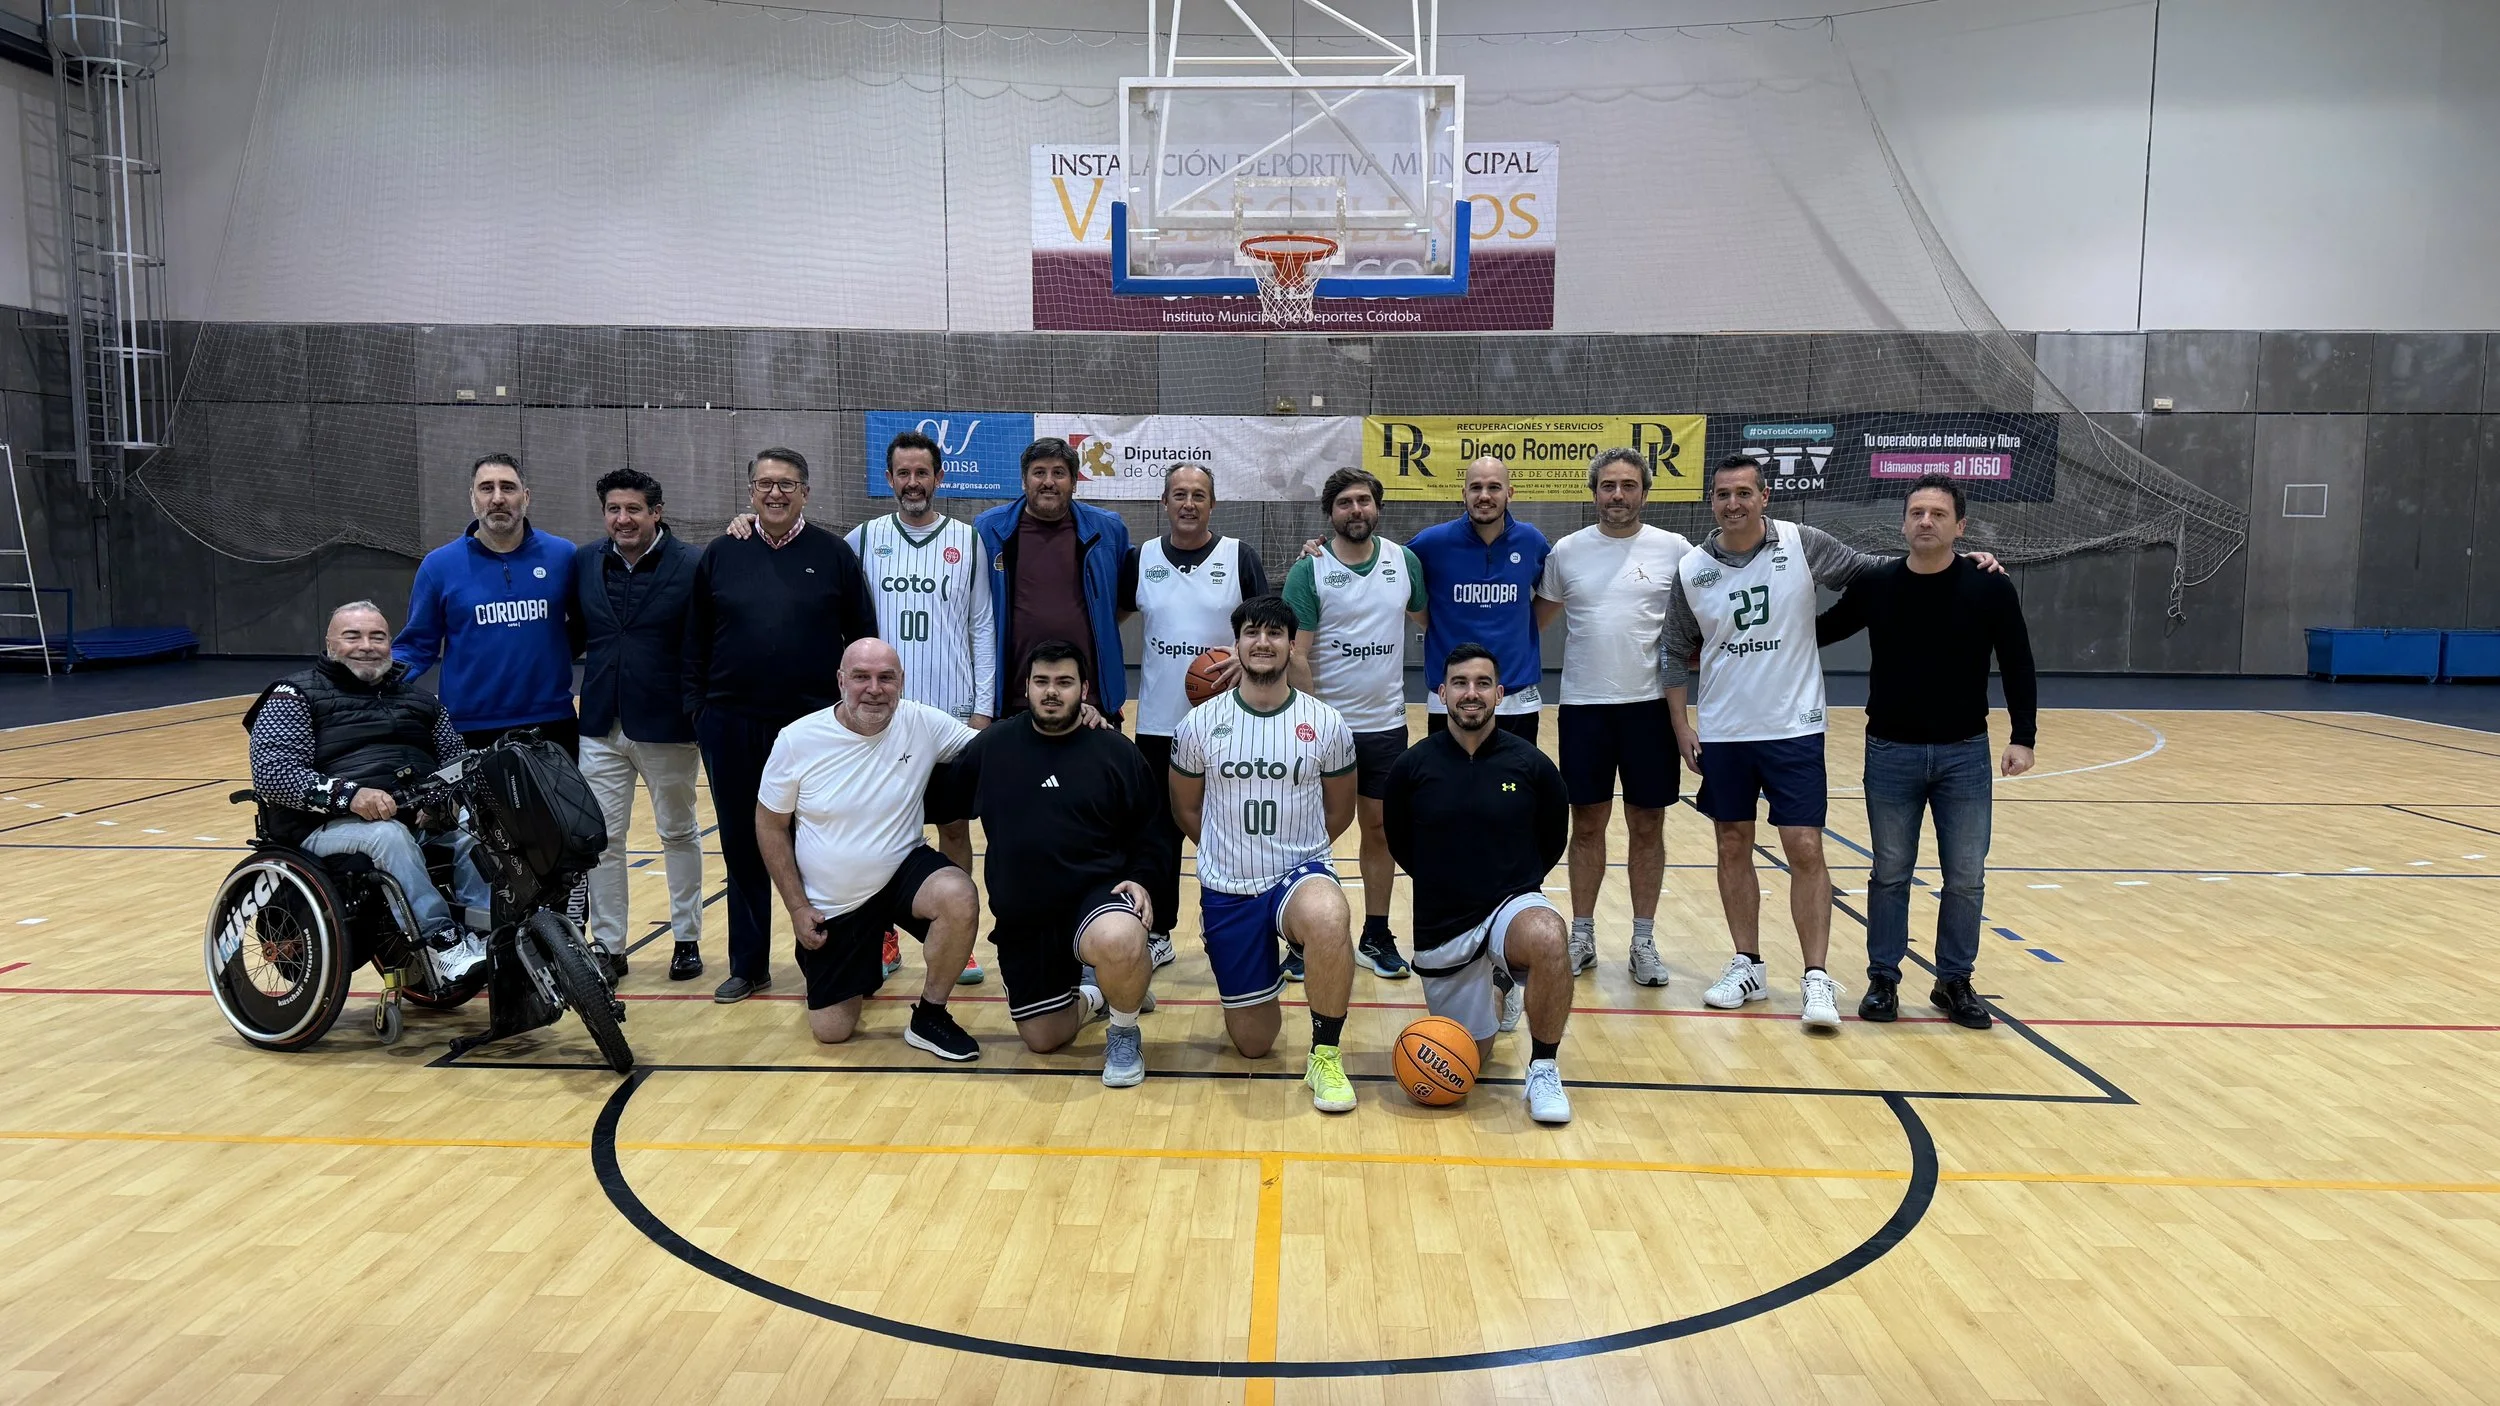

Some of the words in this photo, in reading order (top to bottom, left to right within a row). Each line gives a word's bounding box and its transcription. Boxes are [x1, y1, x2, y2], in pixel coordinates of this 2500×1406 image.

[1237, 153, 1375, 176] DEPORTIVA
[1391, 151, 1539, 175] MUNCIPAL
[1162, 310, 1215, 323] Instituto
[1218, 310, 1282, 324] Municipal
[1304, 310, 1363, 325] Deportes
[1366, 309, 1421, 323] Córdoba
[1457, 422, 1543, 431] RECUPERACIONES
[1545, 422, 1551, 430] Y
[1554, 422, 1604, 431] SERVICIOS
[1749, 428, 1827, 437] #DeTotalConfianza
[1461, 438, 1516, 461] Diego
[1523, 438, 1598, 460] Romero
[1864, 433, 1875, 447] Tu
[1877, 433, 1927, 448] operadora
[1929, 433, 1941, 447] de
[1944, 433, 1987, 448] telefonía
[1989, 436, 1995, 449] y
[1997, 433, 2021, 448] fibra
[1124, 446, 1211, 462] Diputación
[1742, 446, 1833, 475] PTV
[942, 460, 979, 473] onsa
[1124, 465, 1142, 478] de
[1880, 460, 1922, 473] Llámanos
[1924, 461, 1950, 475] gratis
[1954, 457, 1966, 475] al
[1969, 457, 2000, 476] 1650
[938, 482, 1000, 490] ww.argonsa.com
[1764, 478, 1824, 490] LECOM
[881, 574, 936, 593] coto
[1729, 584, 1770, 631] 23
[900, 610, 929, 642] 00
[1157, 641, 1211, 659] Sepisur
[1341, 641, 1395, 661] Sepisur
[1727, 638, 1781, 657] episur
[1220, 757, 1287, 780] coto
[1243, 799, 1277, 836] 00
[1417, 1043, 1465, 1089] Wilson
